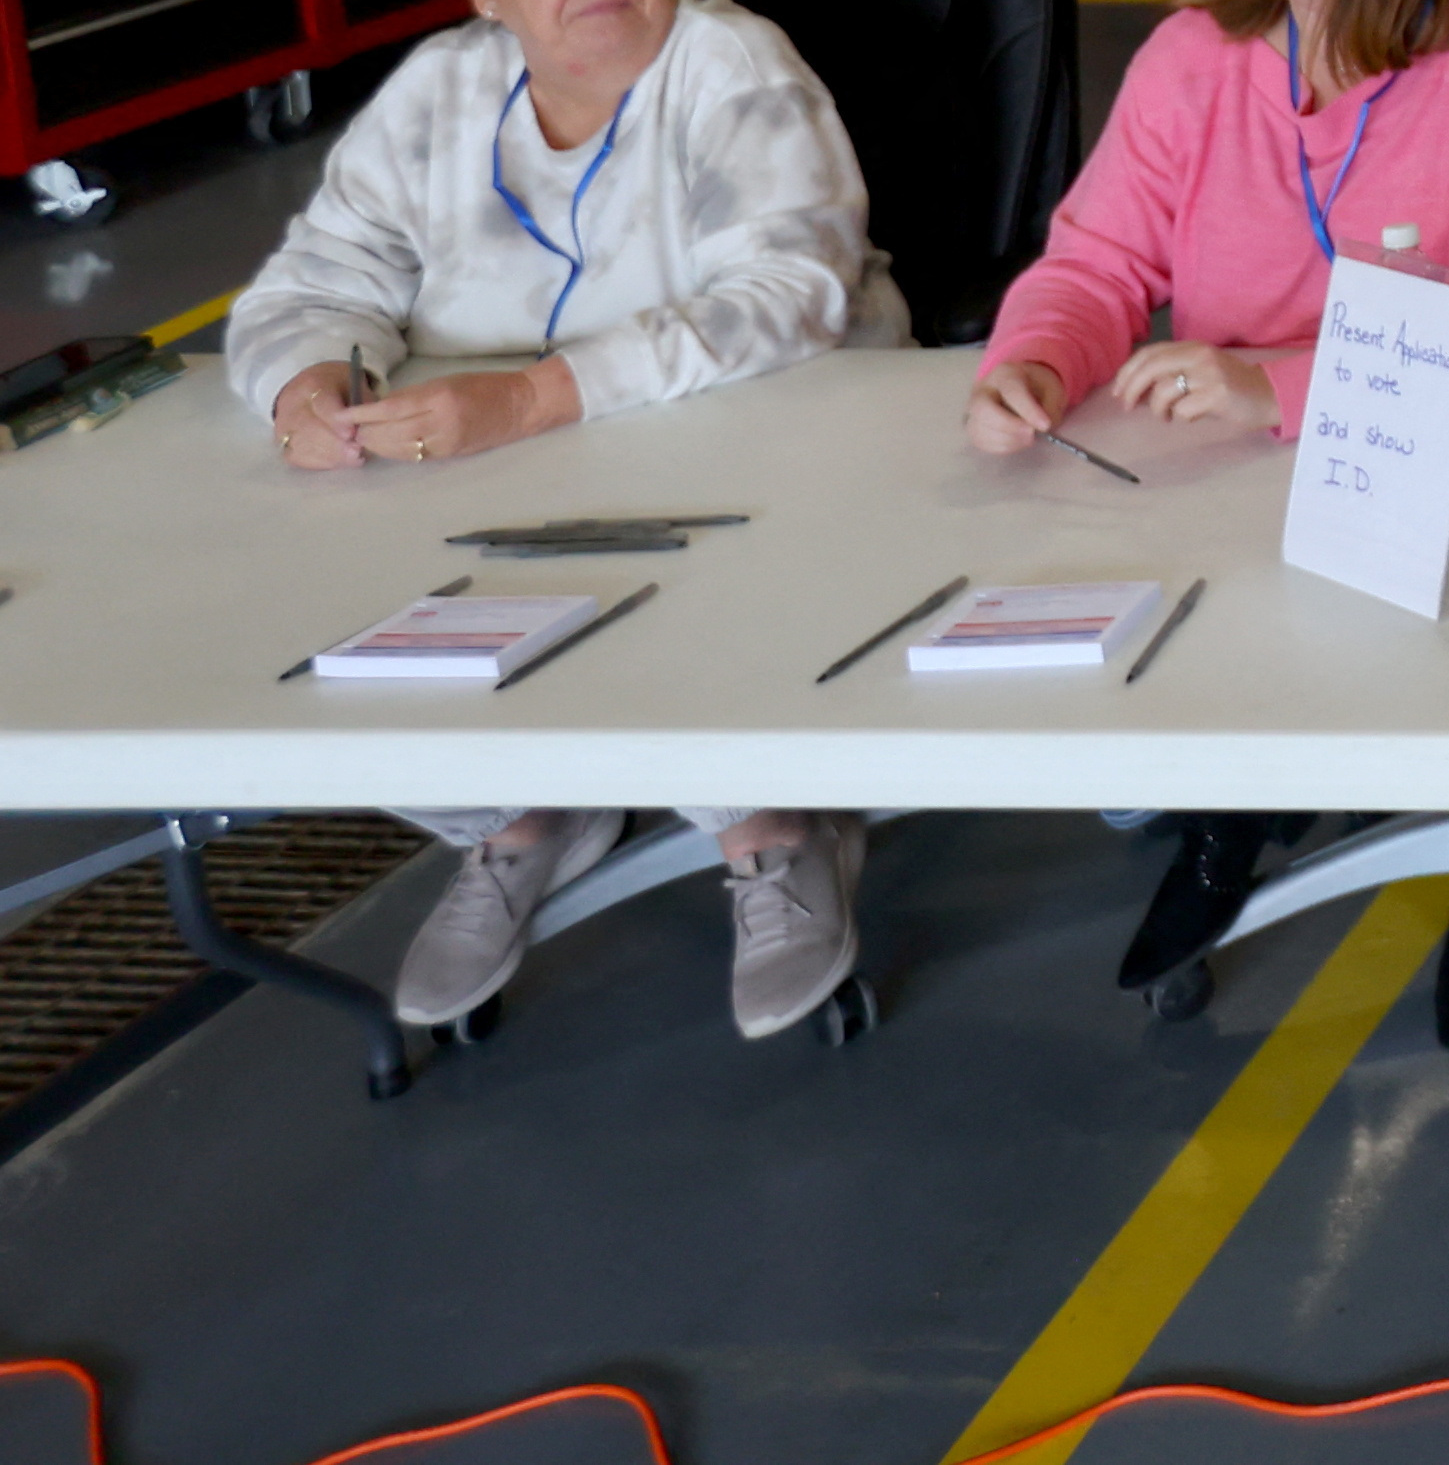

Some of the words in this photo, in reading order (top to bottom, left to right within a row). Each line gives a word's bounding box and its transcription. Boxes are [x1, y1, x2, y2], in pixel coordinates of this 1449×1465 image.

[1330, 301, 1385, 350] Present
[1335, 357, 1352, 382] to
[1366, 373, 1401, 395] vote
[1317, 411, 1349, 439] and
[1323, 457, 1374, 496] I.D.
